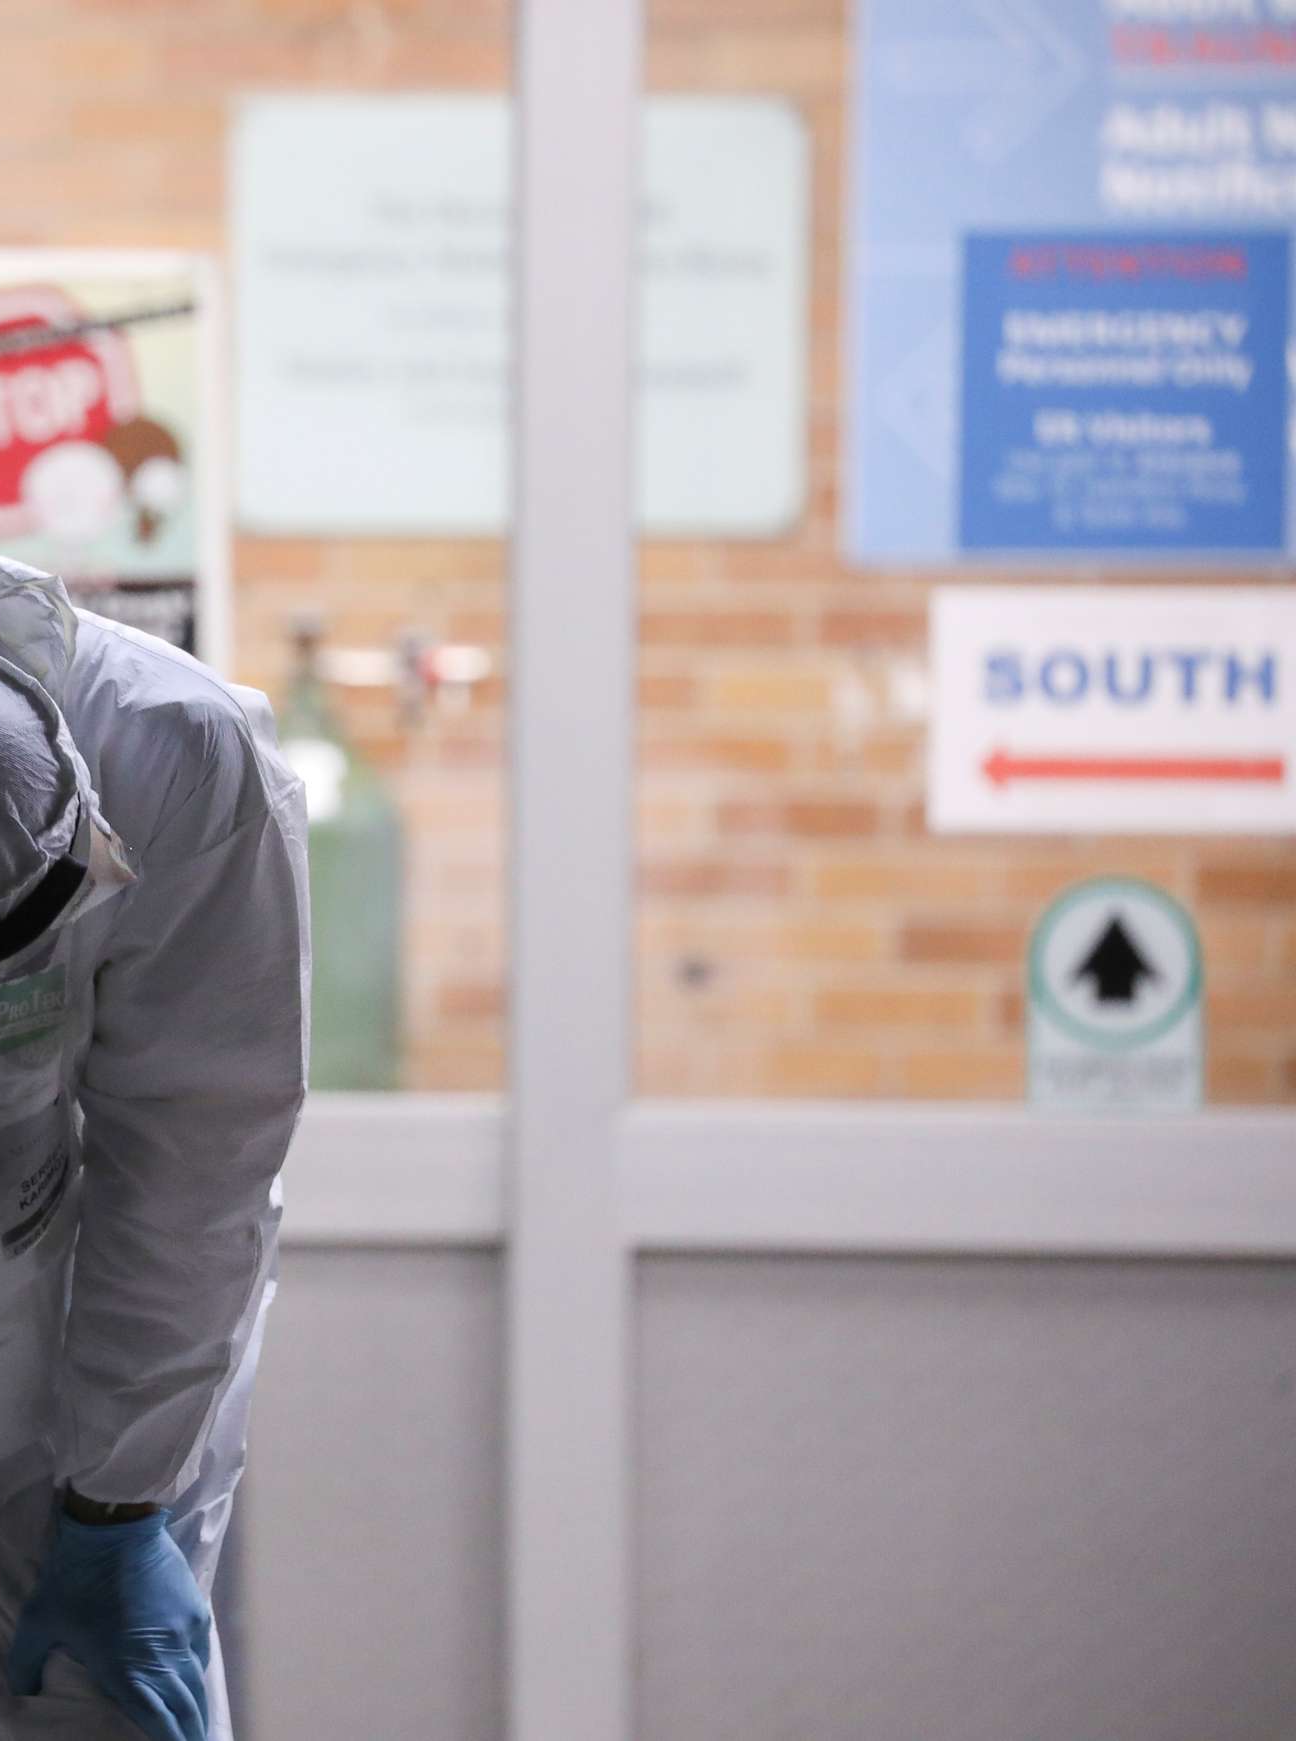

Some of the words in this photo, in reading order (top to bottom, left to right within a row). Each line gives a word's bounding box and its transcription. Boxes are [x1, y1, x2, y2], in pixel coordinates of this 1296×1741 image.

[1010, 245, 1248, 281] ATTENTION
[1005, 310, 1248, 347] EMERGENCY
[997, 350, 1164, 386] Personnel
[1171, 353, 1252, 394] Only
[984, 648, 1279, 706] SOUTH
